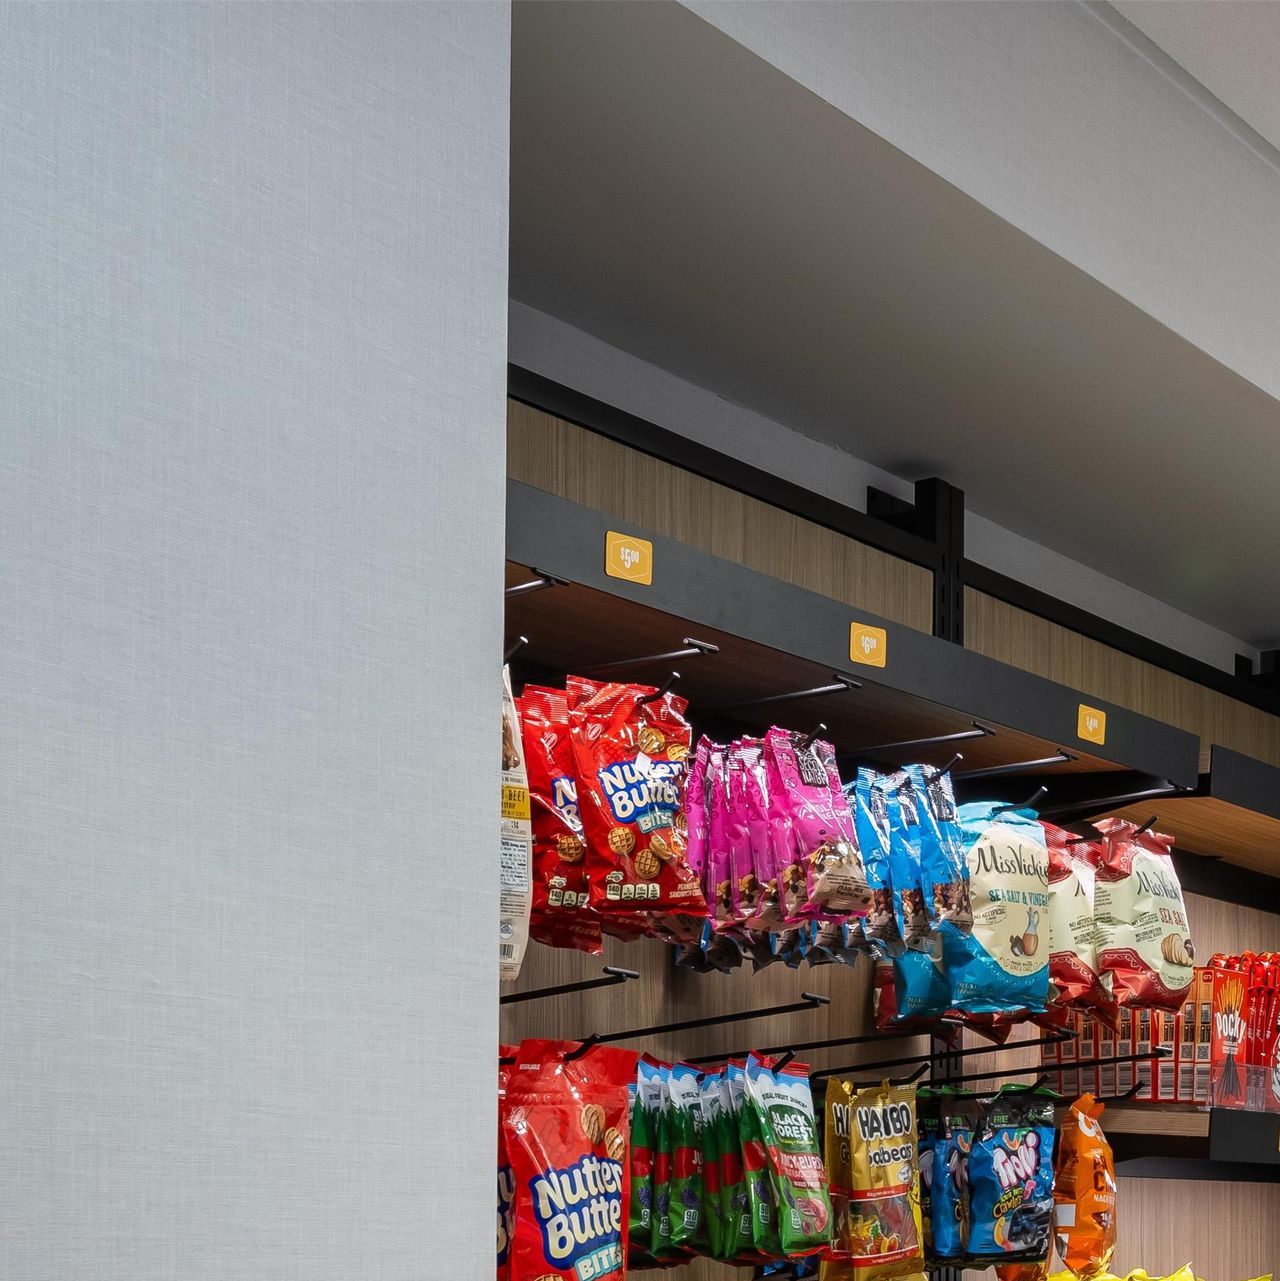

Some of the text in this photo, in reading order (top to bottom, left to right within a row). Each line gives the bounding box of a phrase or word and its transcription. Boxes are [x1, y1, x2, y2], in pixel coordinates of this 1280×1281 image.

[508, 789, 526, 802] BEEF
[611, 778, 680, 818] Butter
[975, 845, 1016, 876] Miss
[607, 885, 620, 894] 140
[988, 889, 1021, 903] SEA SALT
[1214, 1010, 1247, 1044] POCKY
[771, 1111, 807, 1127] BLACK
[774, 1122, 814, 1139] FOREST
[992, 1131, 1039, 1188] Trolli
[535, 1156, 623, 1219] Nutter
[686, 1210, 697, 1221] 90
